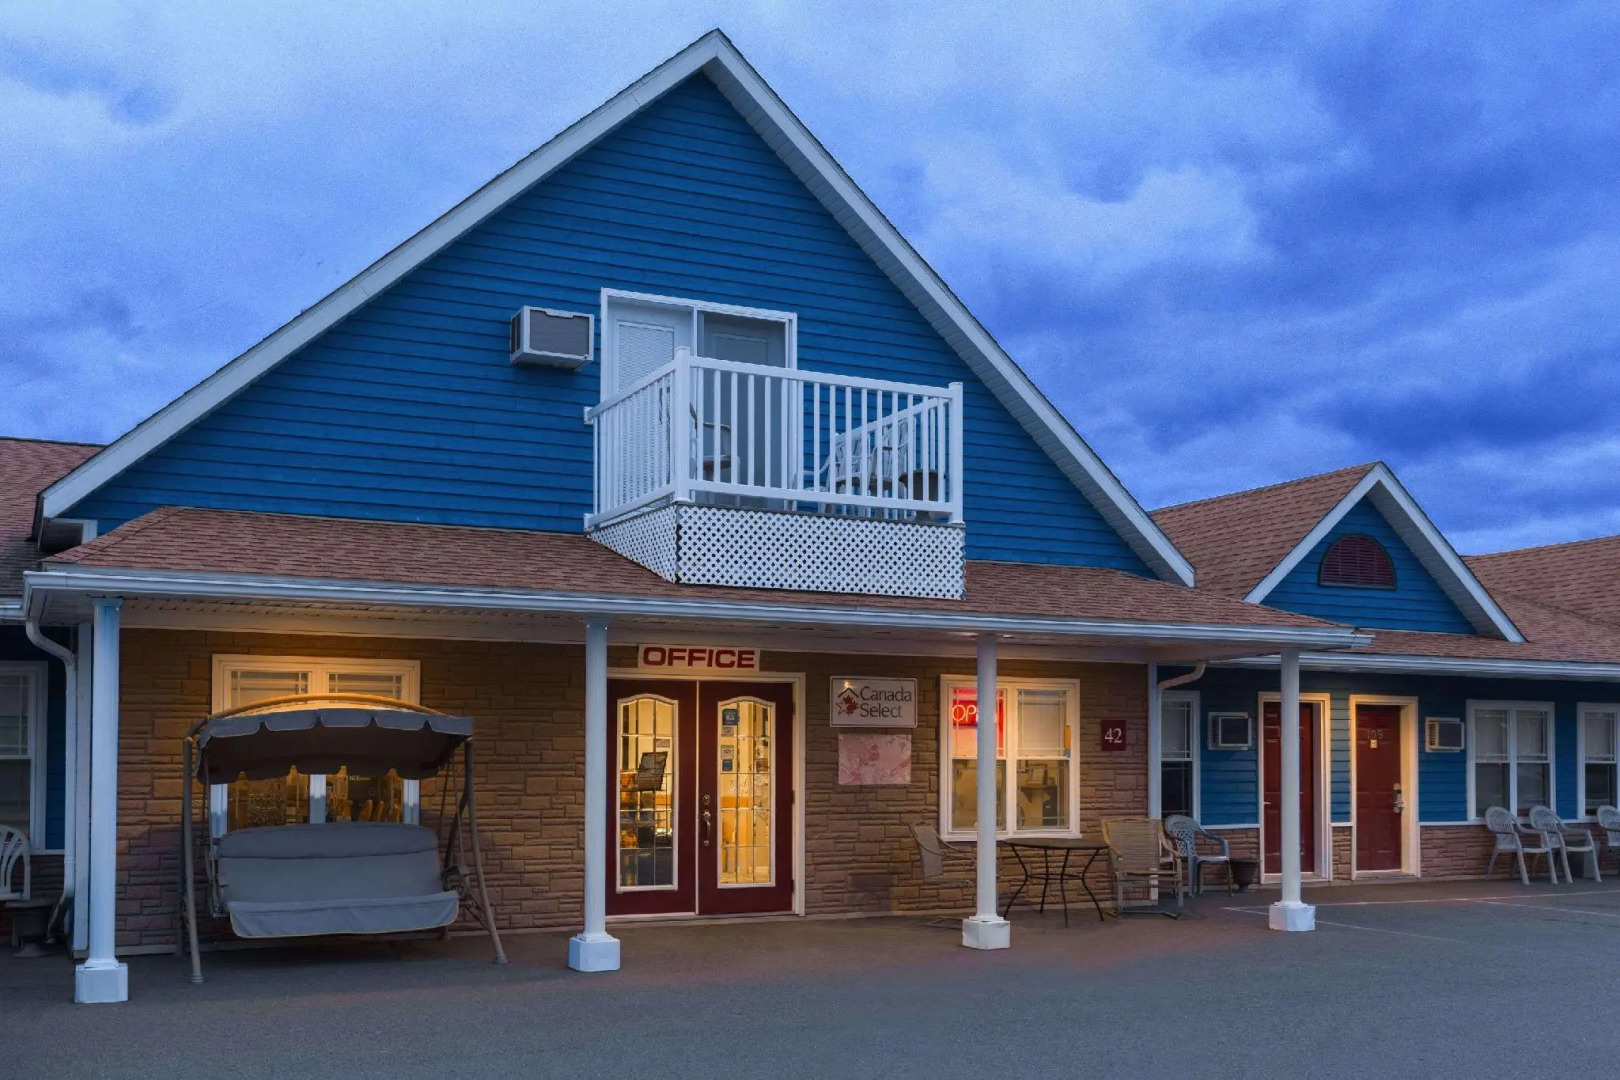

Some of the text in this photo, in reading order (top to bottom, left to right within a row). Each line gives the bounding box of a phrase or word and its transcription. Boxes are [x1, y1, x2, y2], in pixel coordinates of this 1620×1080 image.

[642, 646, 756, 669] OFFICE
[860, 686, 912, 702] Canada
[860, 702, 902, 718] Select
[952, 704, 980, 722] OP
[1104, 727, 1122, 744] 42
